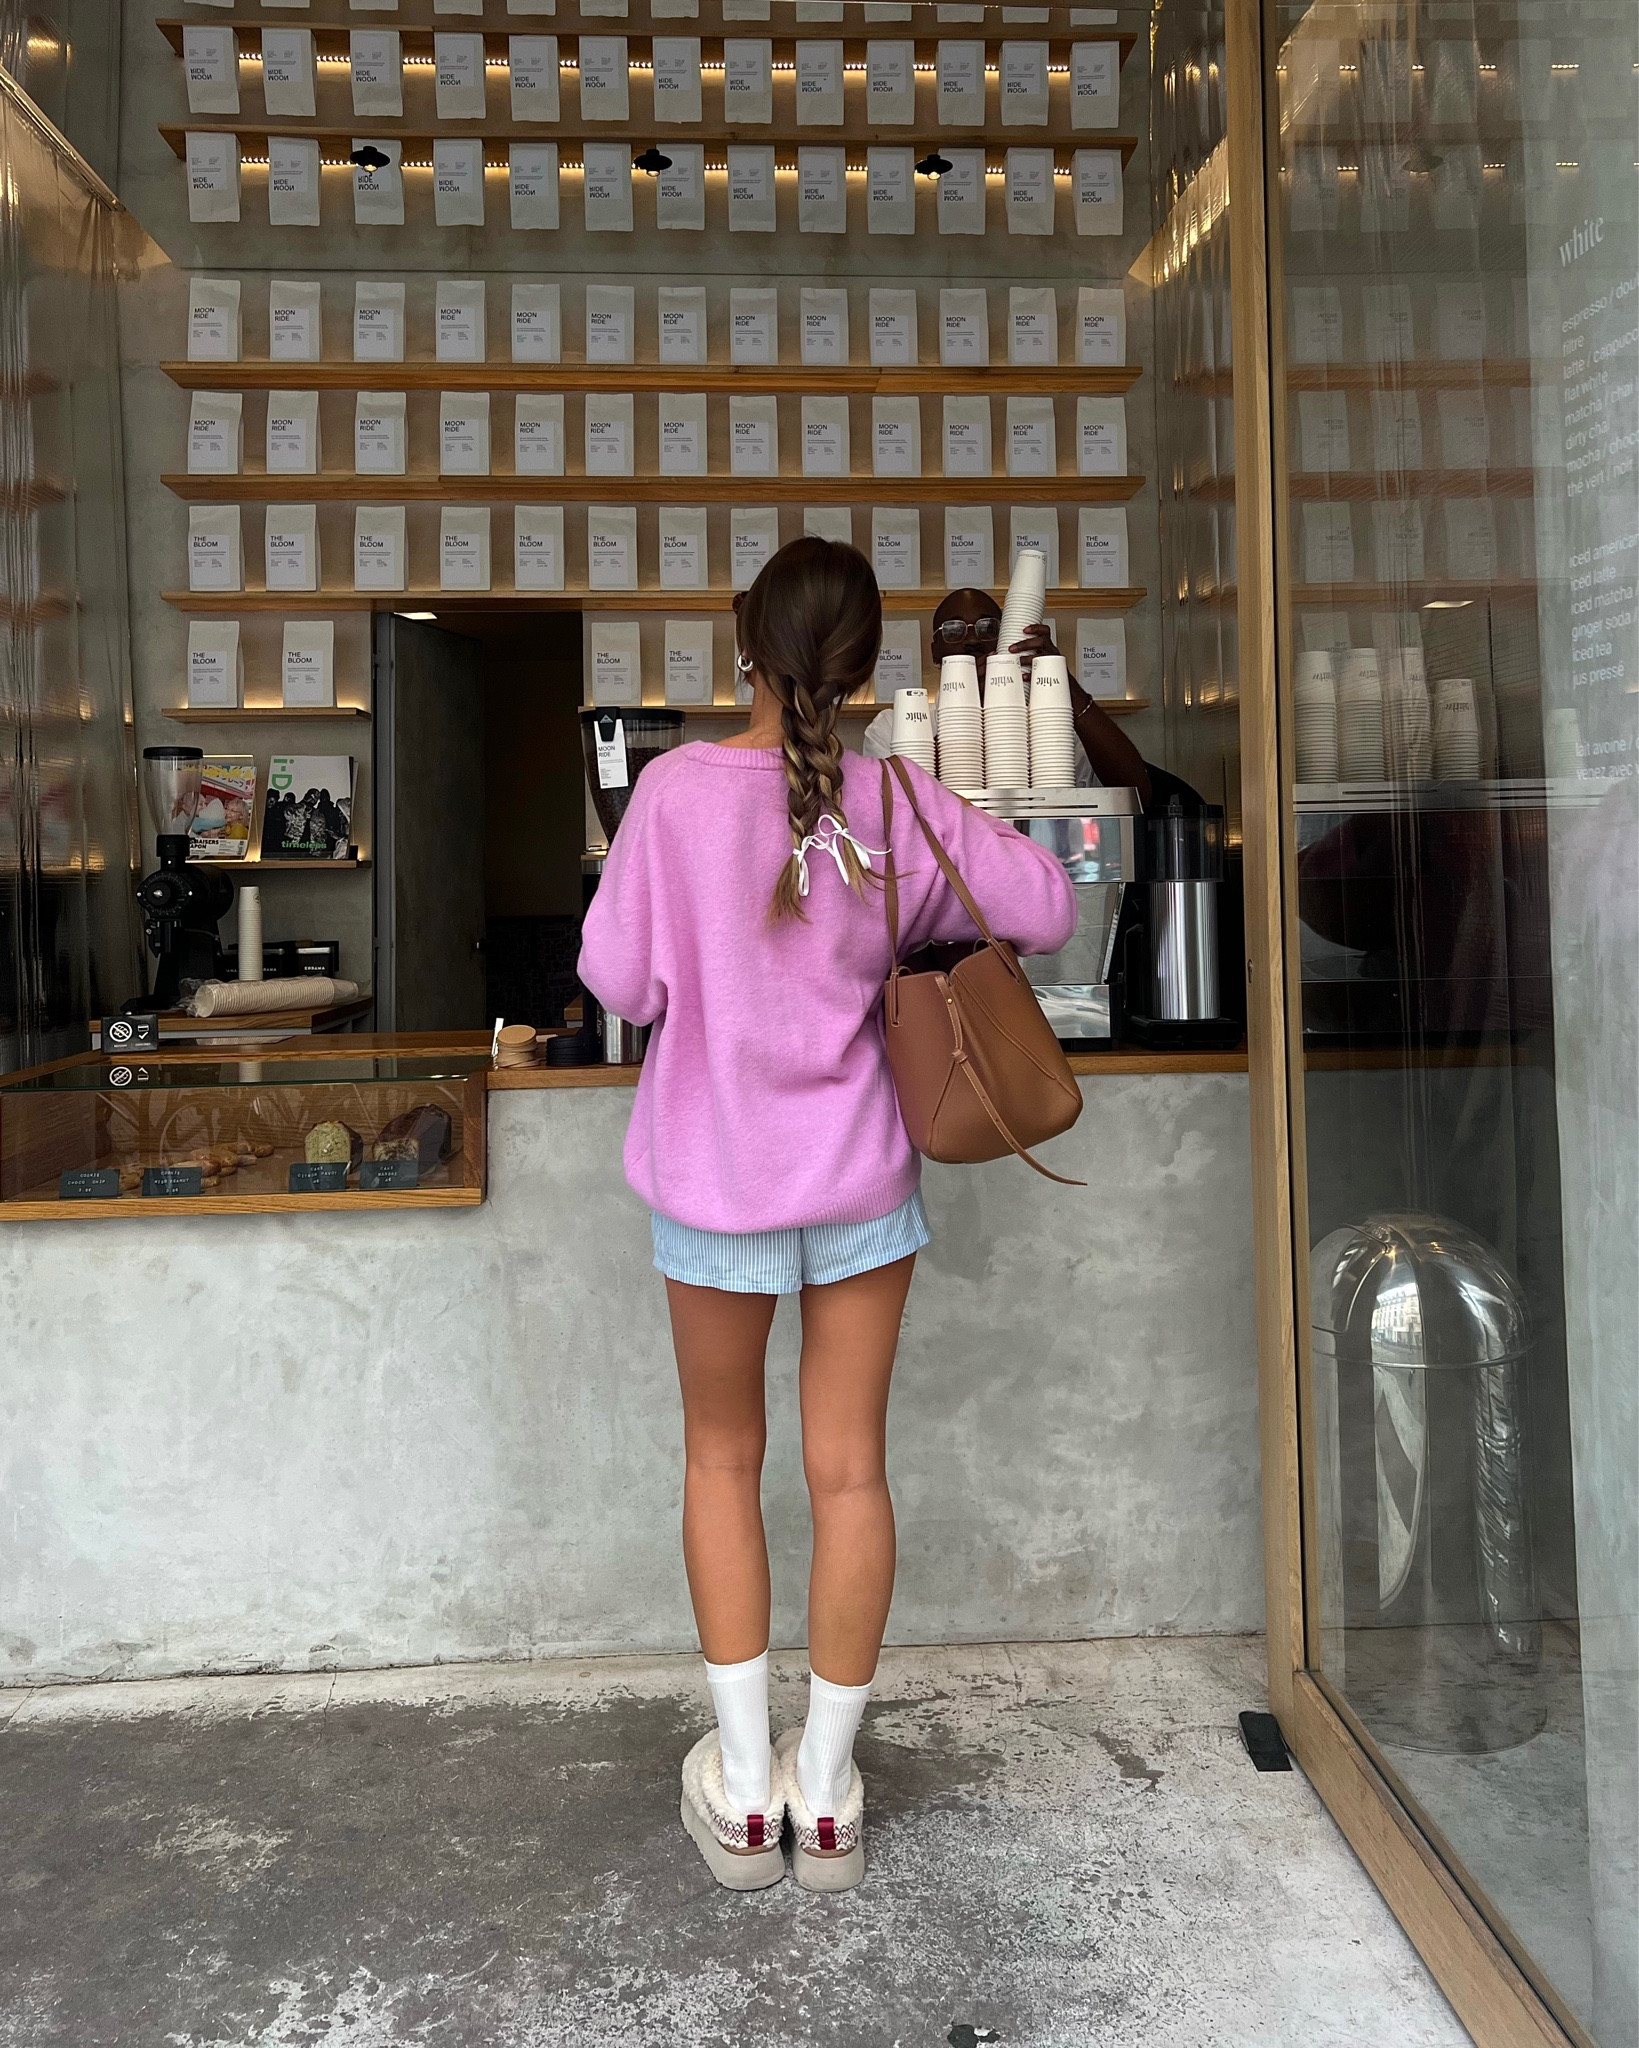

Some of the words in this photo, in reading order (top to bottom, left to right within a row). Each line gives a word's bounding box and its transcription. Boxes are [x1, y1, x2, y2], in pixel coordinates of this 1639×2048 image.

[1559, 217, 1604, 267] white
[1562, 297, 1607, 333] espresso
[1563, 360, 1585, 380] latte
[1581, 370, 1608, 394] white
[1565, 399, 1602, 428] matcha
[1566, 430, 1588, 450] dirty
[1567, 449, 1600, 474] mocha
[1570, 547, 1591, 568] iced
[1570, 571, 1592, 592] iced
[1593, 566, 1616, 585] latte
[1570, 595, 1592, 615] iced
[1594, 586, 1633, 608] matcha
[1572, 619, 1604, 642] ginger
[1605, 610, 1631, 631] soda
[1572, 643, 1594, 662] iced
[1595, 641, 1612, 658] tea
[942, 682, 966, 692] white
[990, 676, 1014, 687] white
[1036, 676, 1060, 687] white
[1572, 669, 1588, 690] jus
[905, 712, 928, 722] white
[1575, 741, 1590, 757] lait
